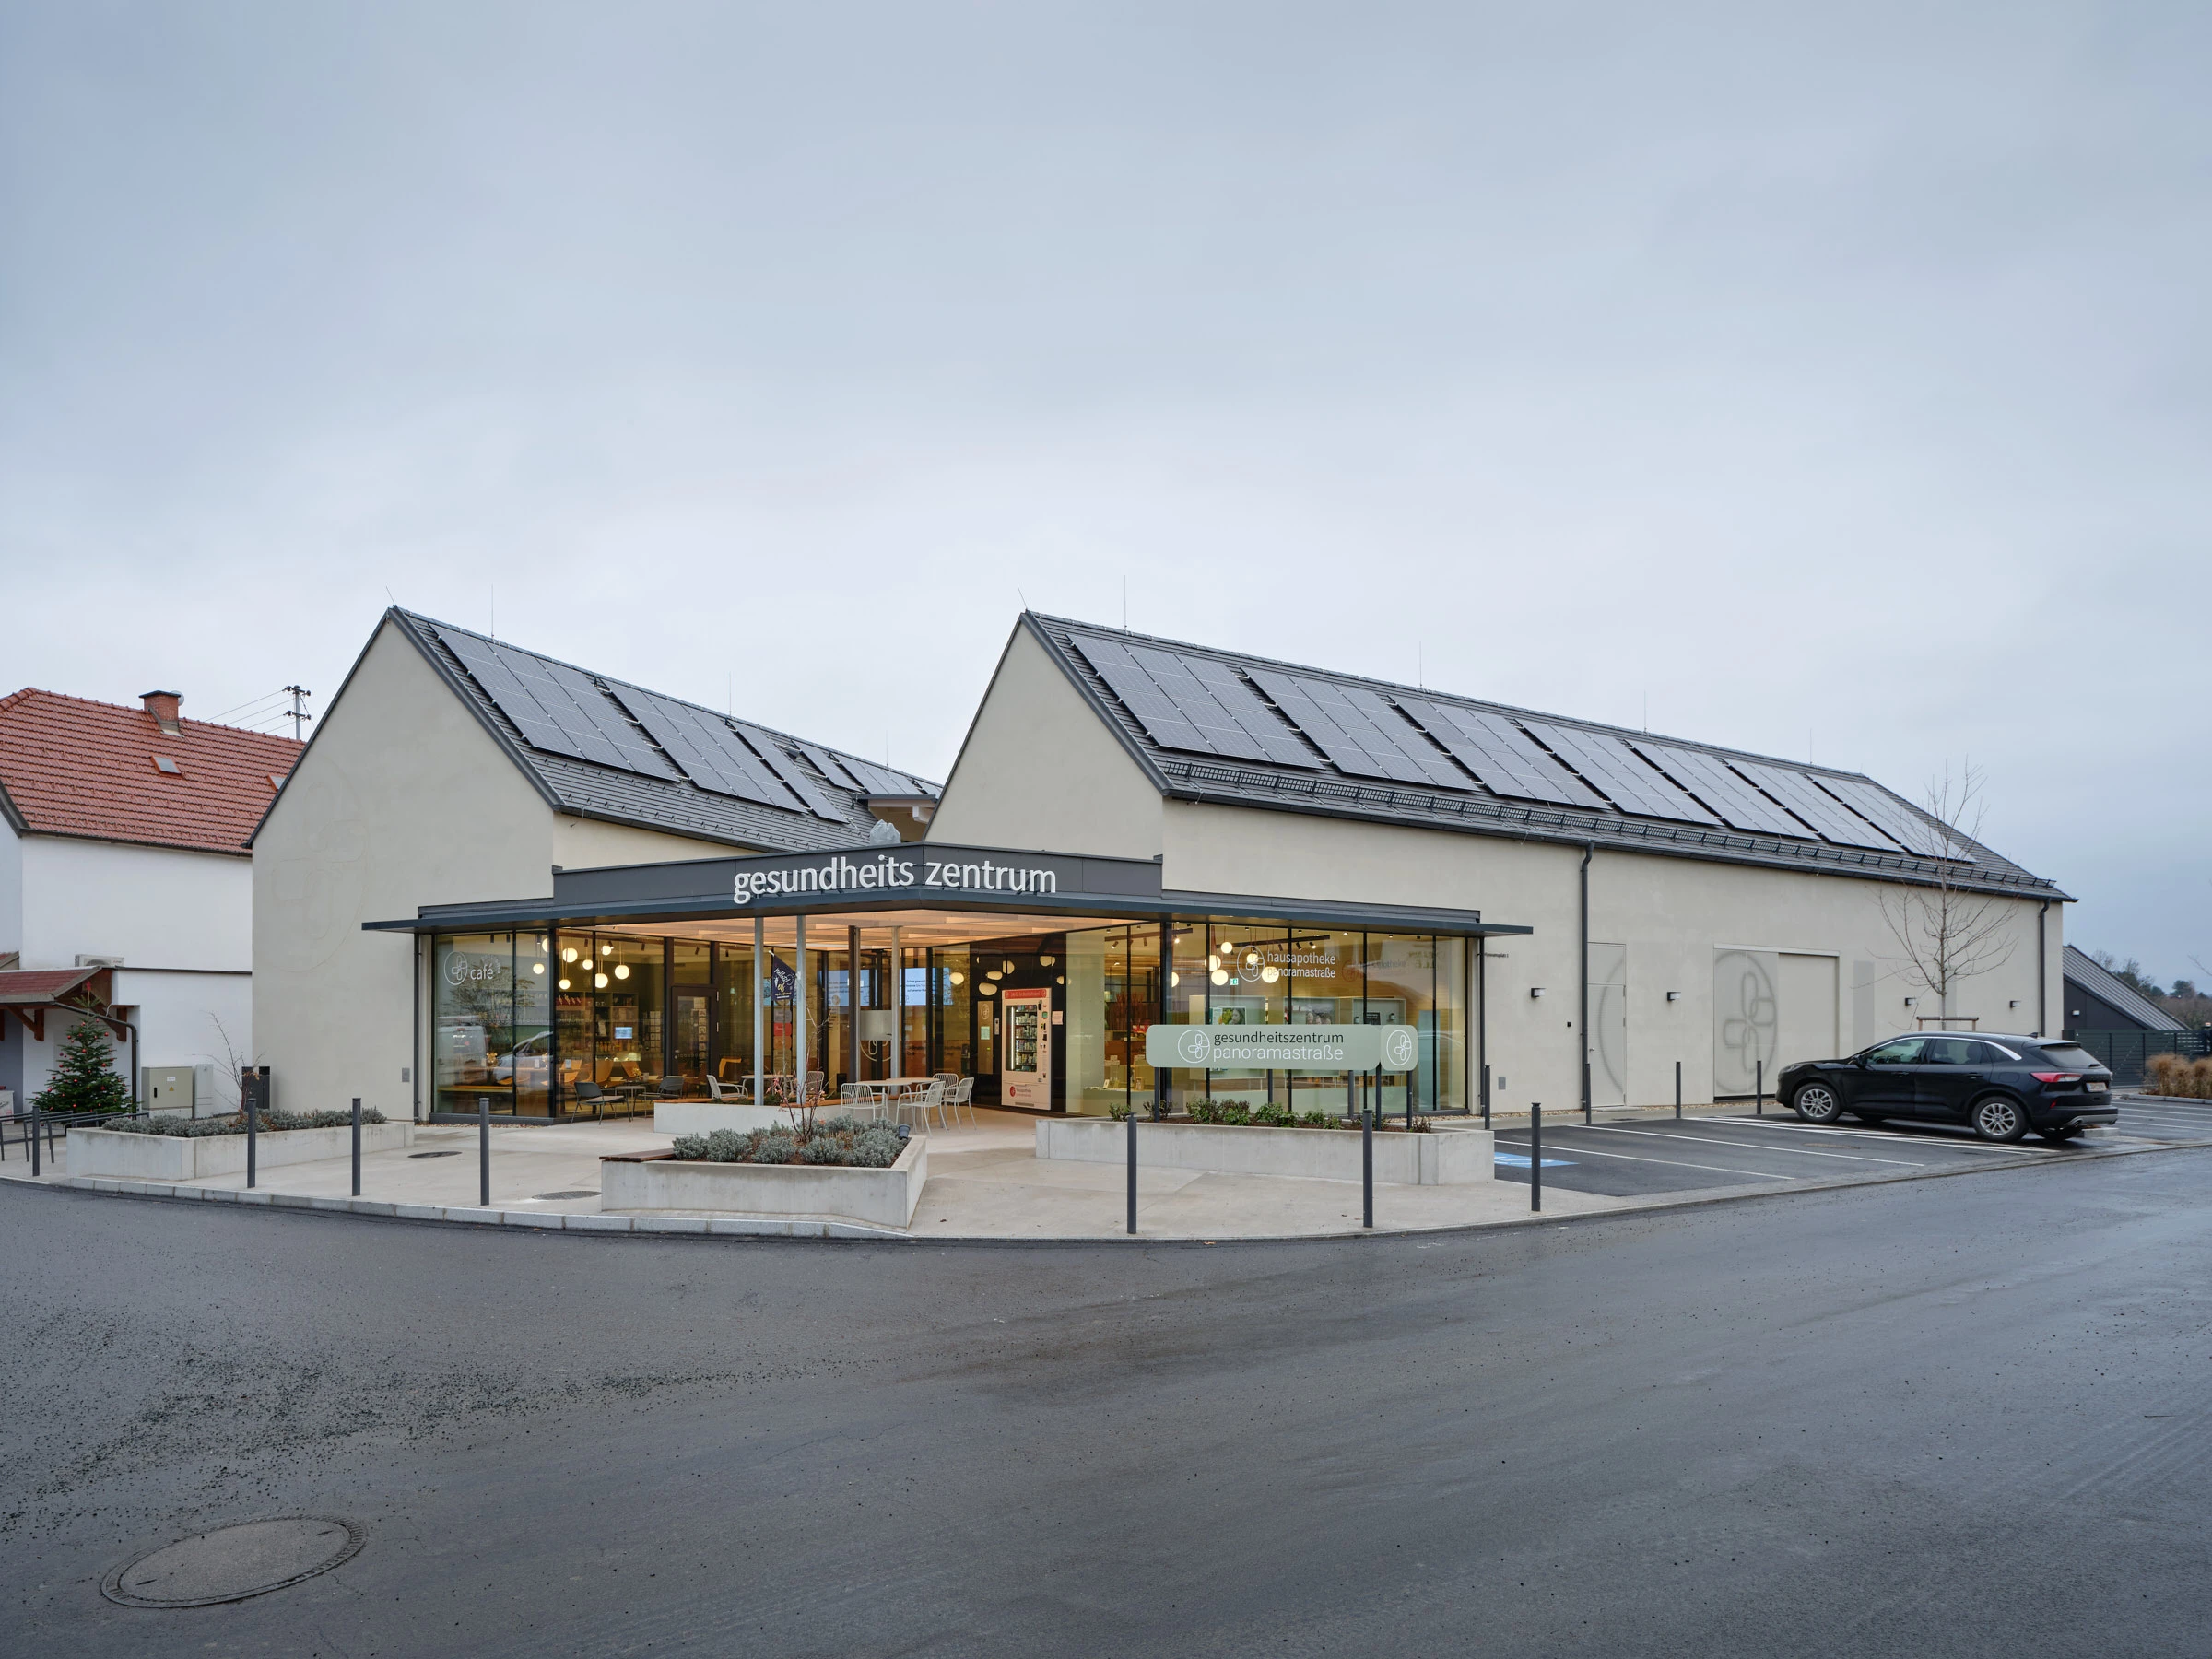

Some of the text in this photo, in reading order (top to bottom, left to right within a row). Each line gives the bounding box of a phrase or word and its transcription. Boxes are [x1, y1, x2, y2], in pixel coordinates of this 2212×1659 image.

[734, 854, 1056, 904] gesundheits zentrum
[1267, 951, 1335, 965] hausapotheke
[470, 963, 493, 980] café
[1267, 966, 1335, 979] panoramastraße
[1214, 1031, 1344, 1046] gesundheitszentrum
[1213, 1045, 1344, 1062] panoramastraße
